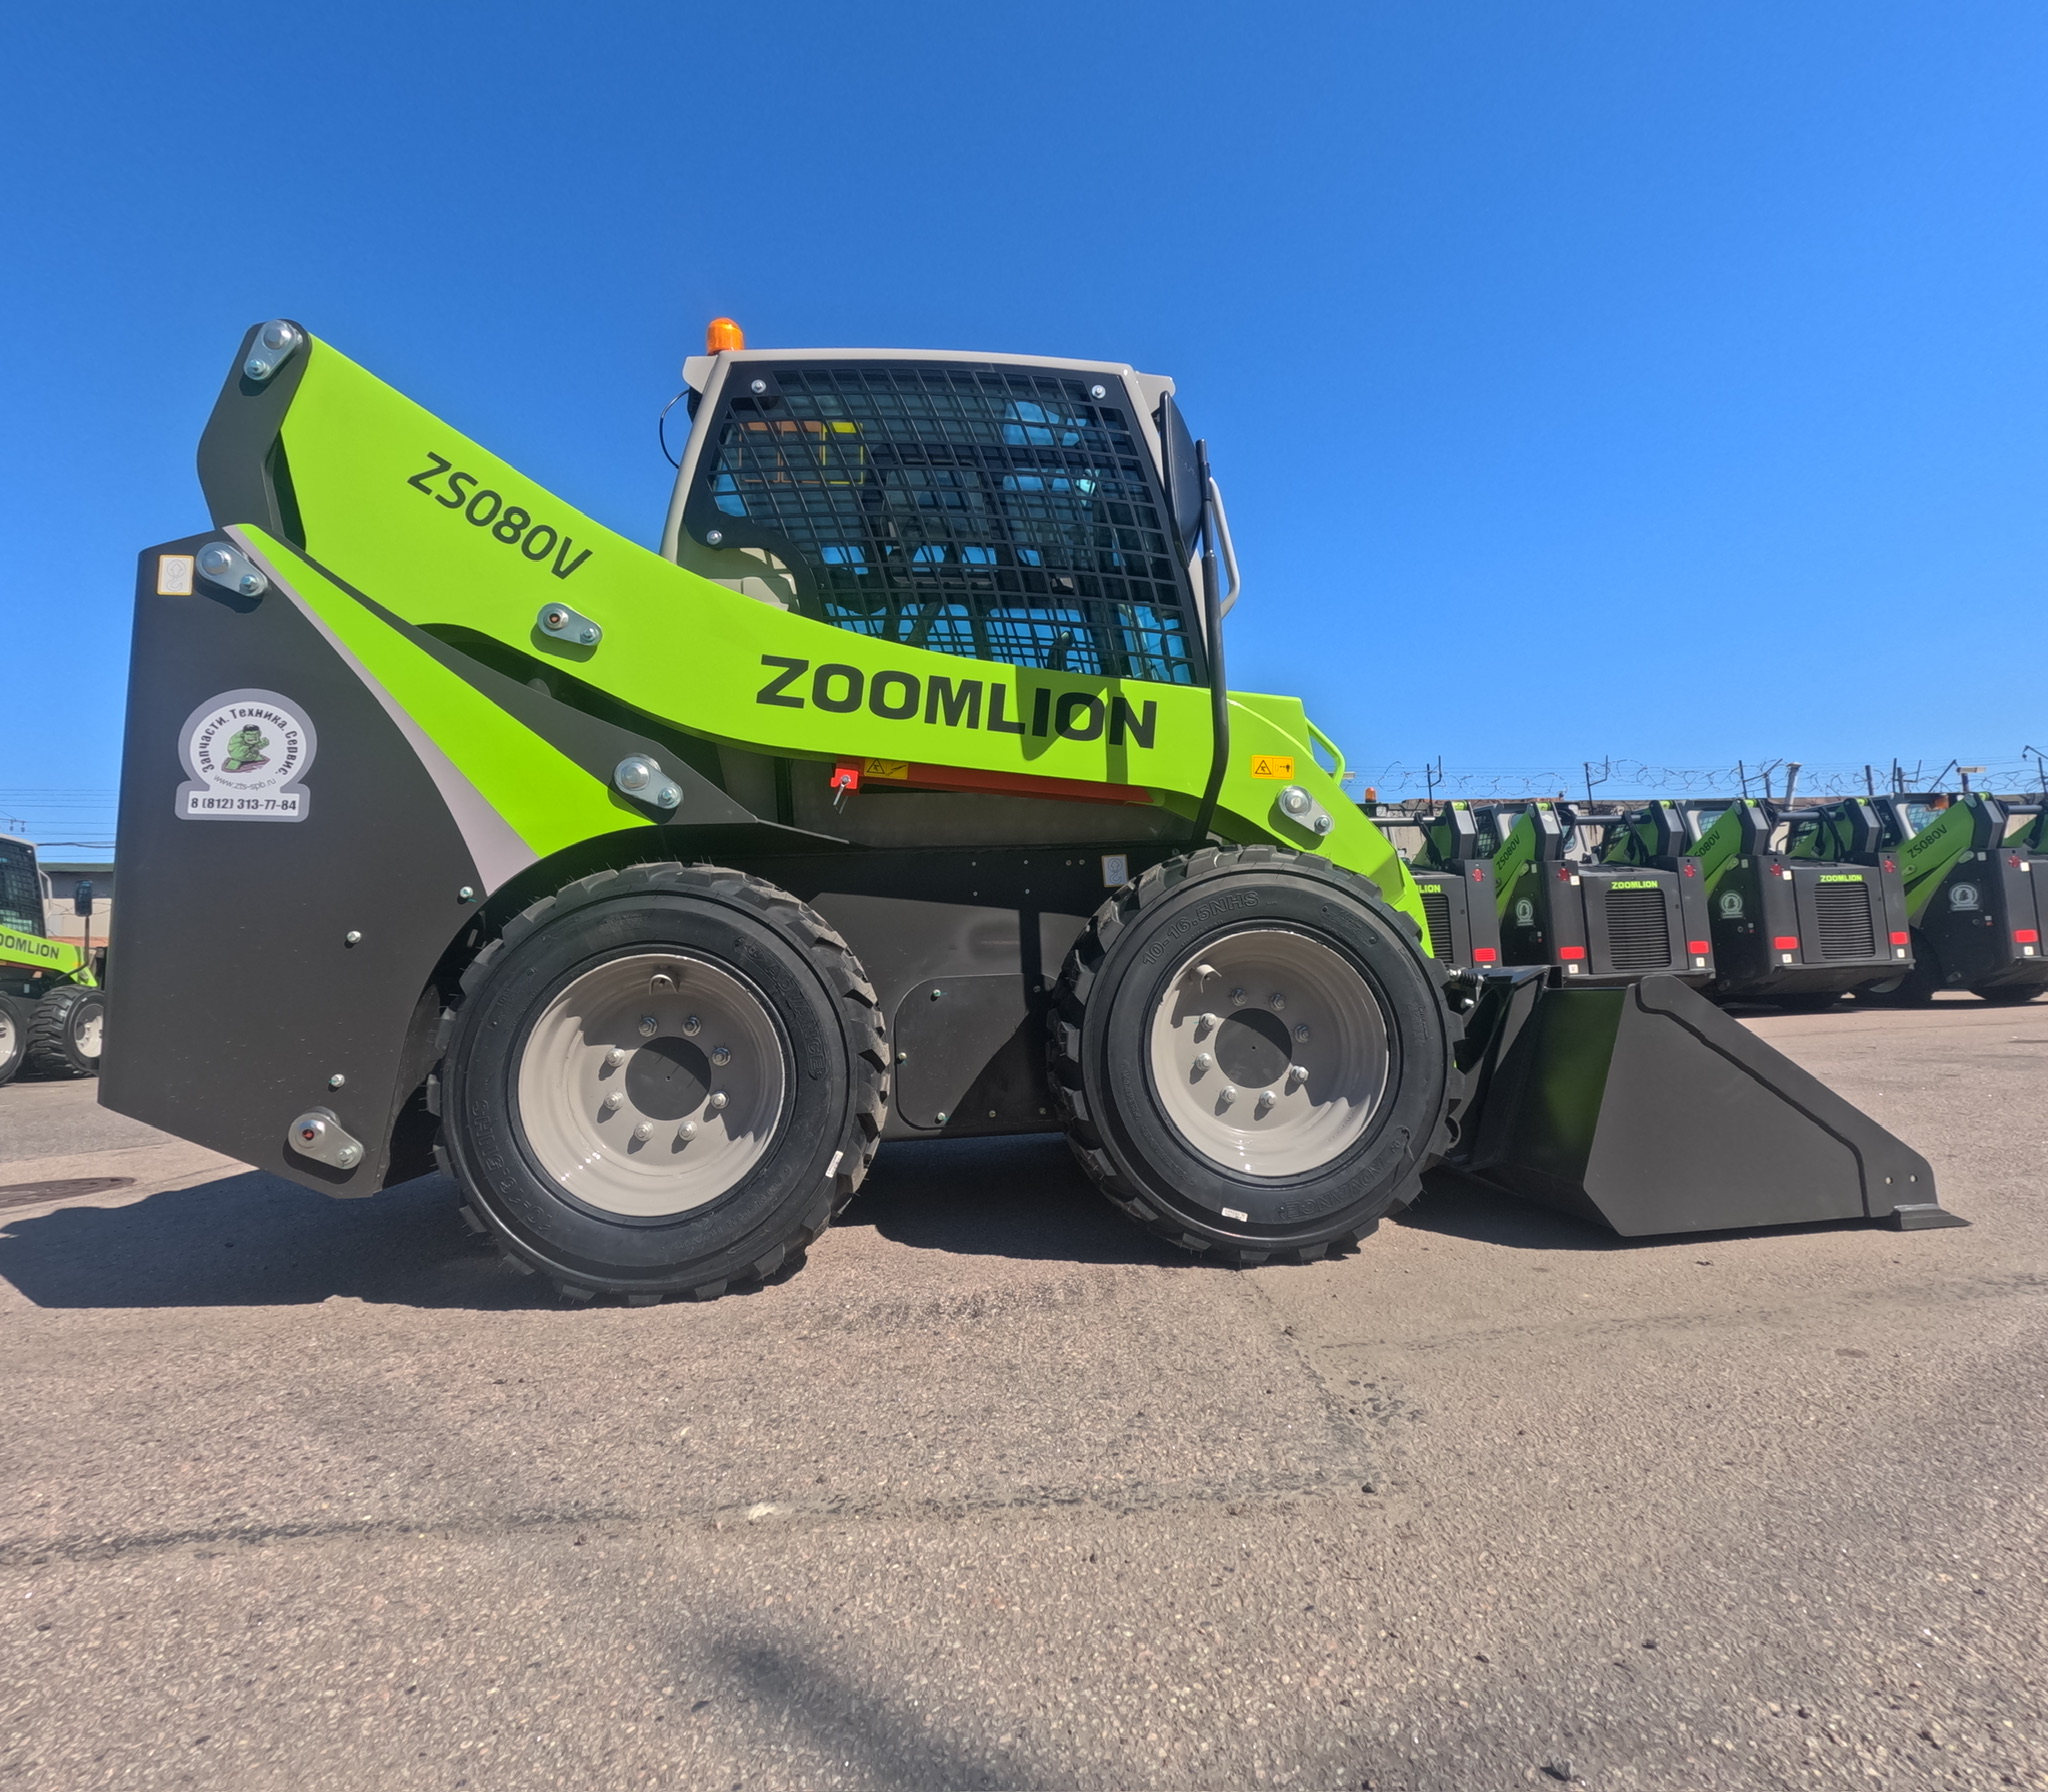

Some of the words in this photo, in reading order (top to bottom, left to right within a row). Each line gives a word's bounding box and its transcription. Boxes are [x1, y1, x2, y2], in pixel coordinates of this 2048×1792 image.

[406, 450, 594, 581] ZS080V
[756, 653, 1158, 750] ZOOMLION
[198, 715, 230, 774] Запчасти.
[229, 707, 288, 732] Техника.
[275, 729, 299, 776] Сервис.
[213, 774, 276, 792] www.zts-spb.ru
[190, 797, 199, 809] 8
[202, 797, 234, 810] (812)
[237, 798, 297, 811] 313-77-84
[1495, 834, 1521, 871] ZS080V
[1906, 823, 1949, 859] ZS080V
[1611, 880, 1658, 890] ZOOMLION
[1819, 874, 1863, 883] ZOOMLION
[1142, 890, 1262, 967] 10-16.5NHS
